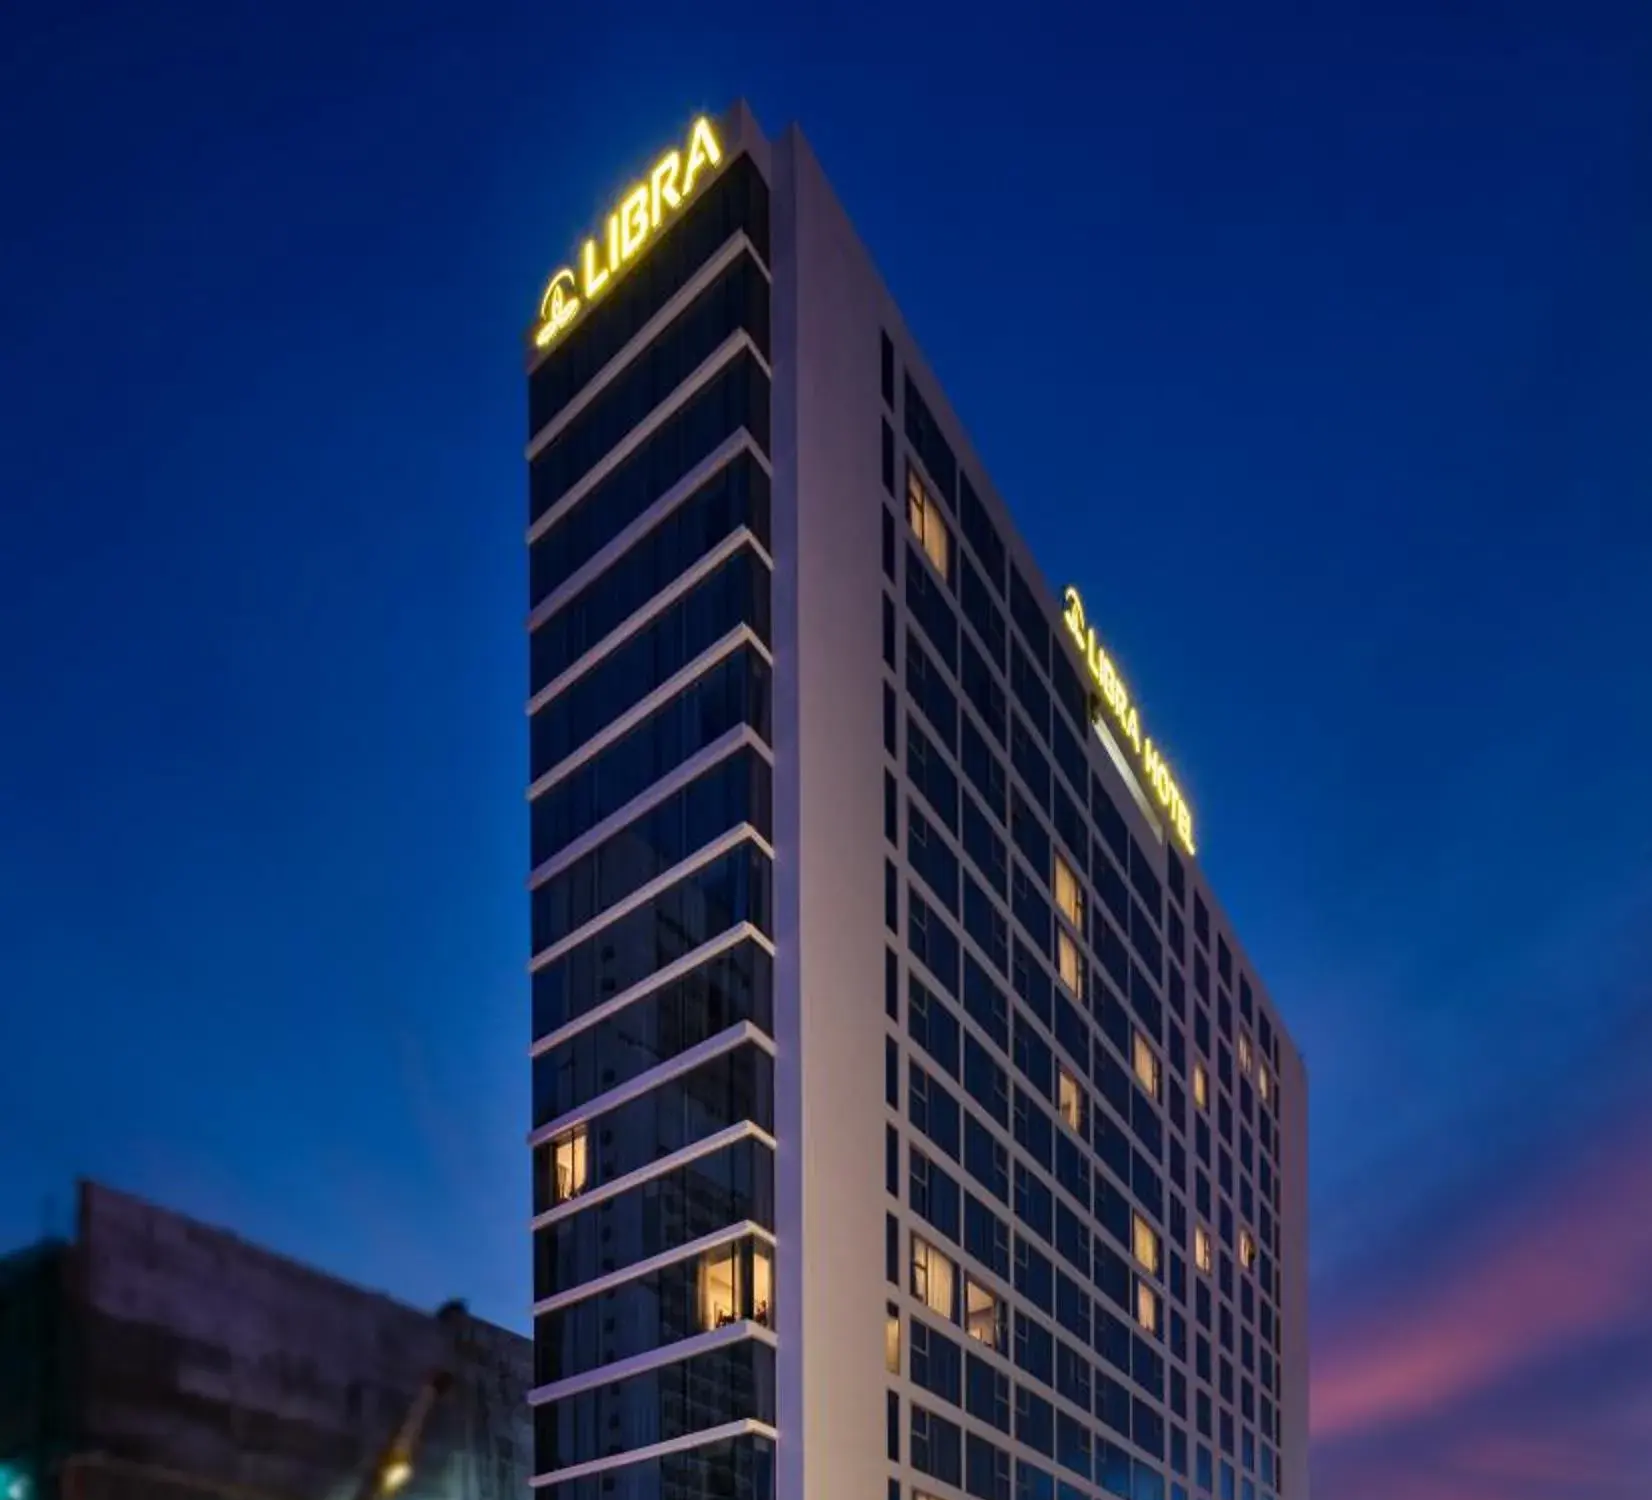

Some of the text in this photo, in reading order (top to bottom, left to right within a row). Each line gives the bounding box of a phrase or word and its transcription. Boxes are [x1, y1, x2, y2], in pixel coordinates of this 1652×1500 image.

[583, 115, 721, 299] LIBRA
[1087, 627, 1195, 856] LIBRA HOTEL
